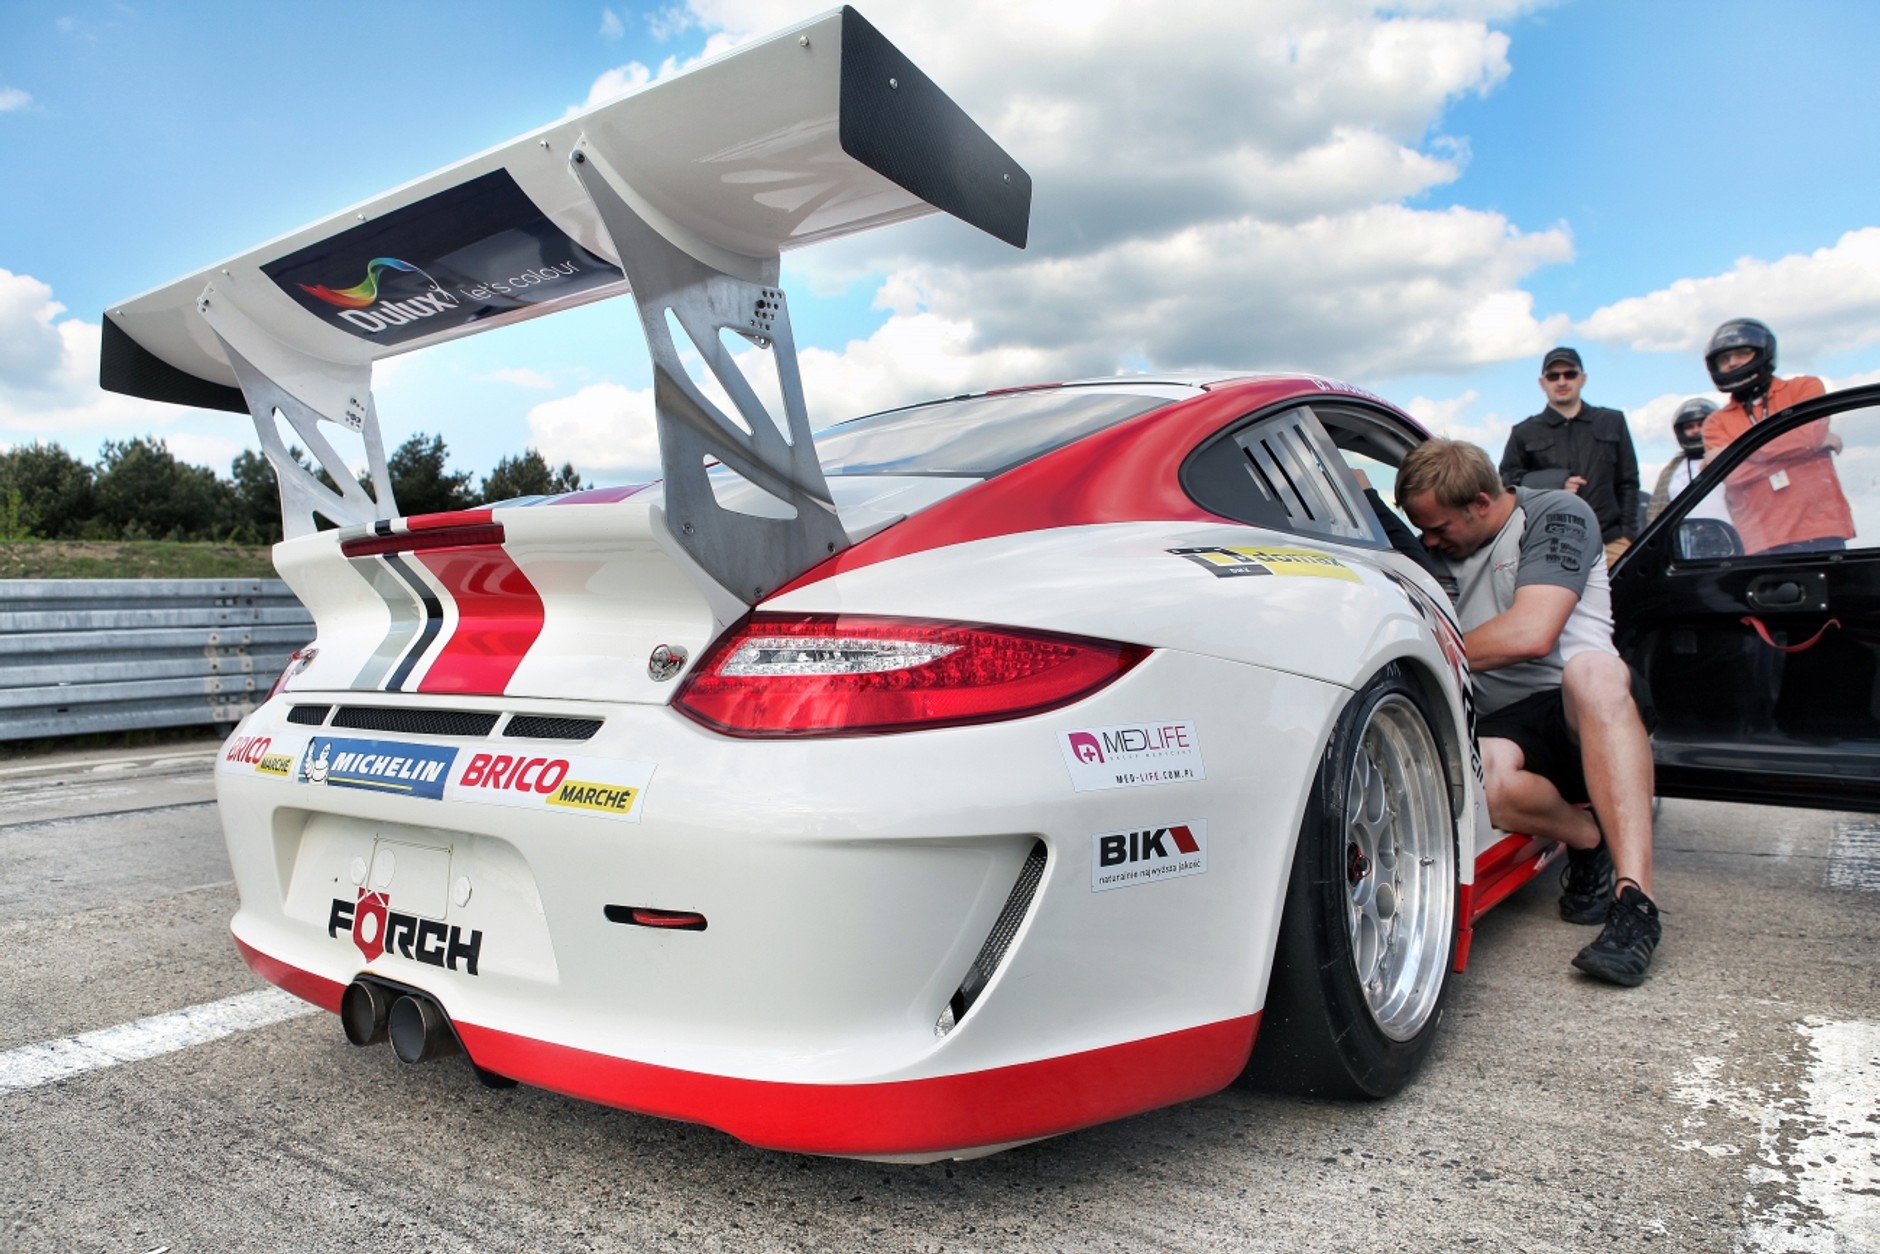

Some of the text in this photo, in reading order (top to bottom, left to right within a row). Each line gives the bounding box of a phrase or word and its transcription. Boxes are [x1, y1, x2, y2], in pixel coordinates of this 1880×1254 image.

[460, 260, 580, 300] let's colour
[337, 292, 459, 333] Dulux
[226, 736, 272, 765] BRICO
[1102, 726, 1190, 753] MEDLIFE
[331, 752, 446, 783] MICHELIN
[459, 753, 570, 794] BRICO
[1115, 768, 1195, 784] MED-LIFE.COM.PL
[559, 785, 632, 810] MARCHÉ
[1100, 827, 1168, 868] BIK
